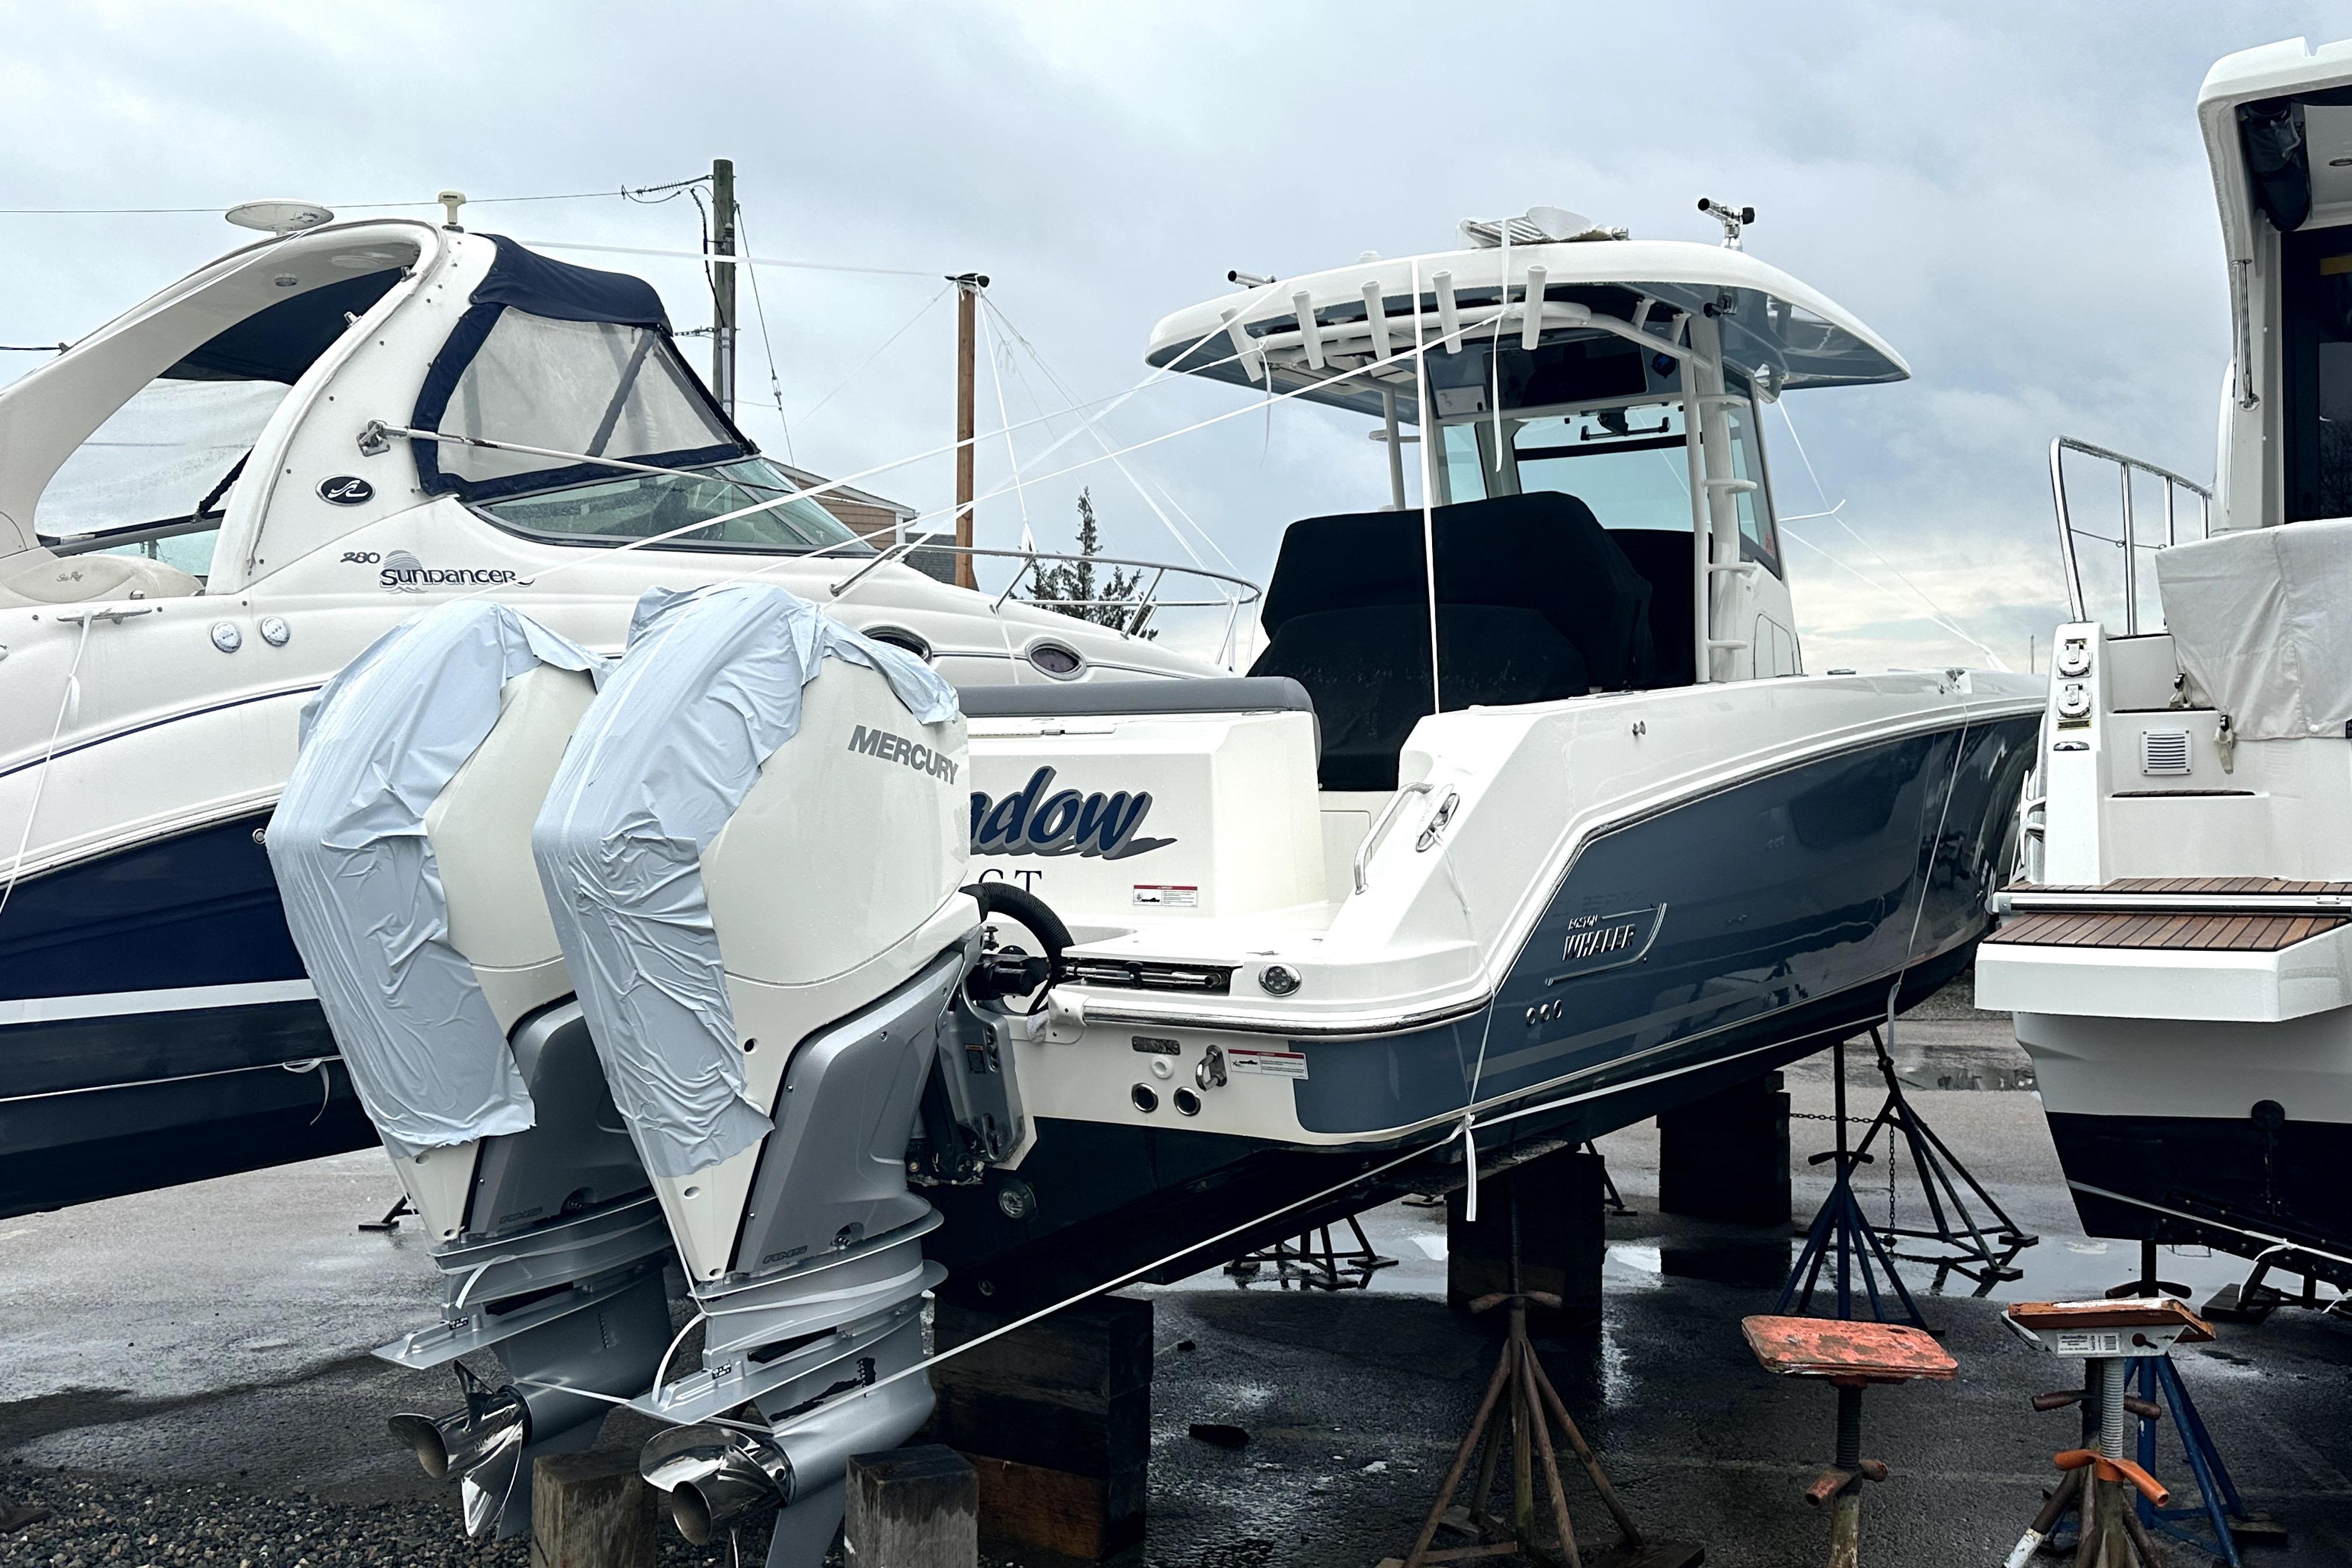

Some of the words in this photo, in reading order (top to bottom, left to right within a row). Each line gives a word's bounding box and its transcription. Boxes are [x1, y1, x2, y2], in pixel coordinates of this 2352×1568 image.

[340, 551, 381, 564] 280
[848, 724, 959, 785] MERCURY
[1561, 923, 1636, 961] WHALER
